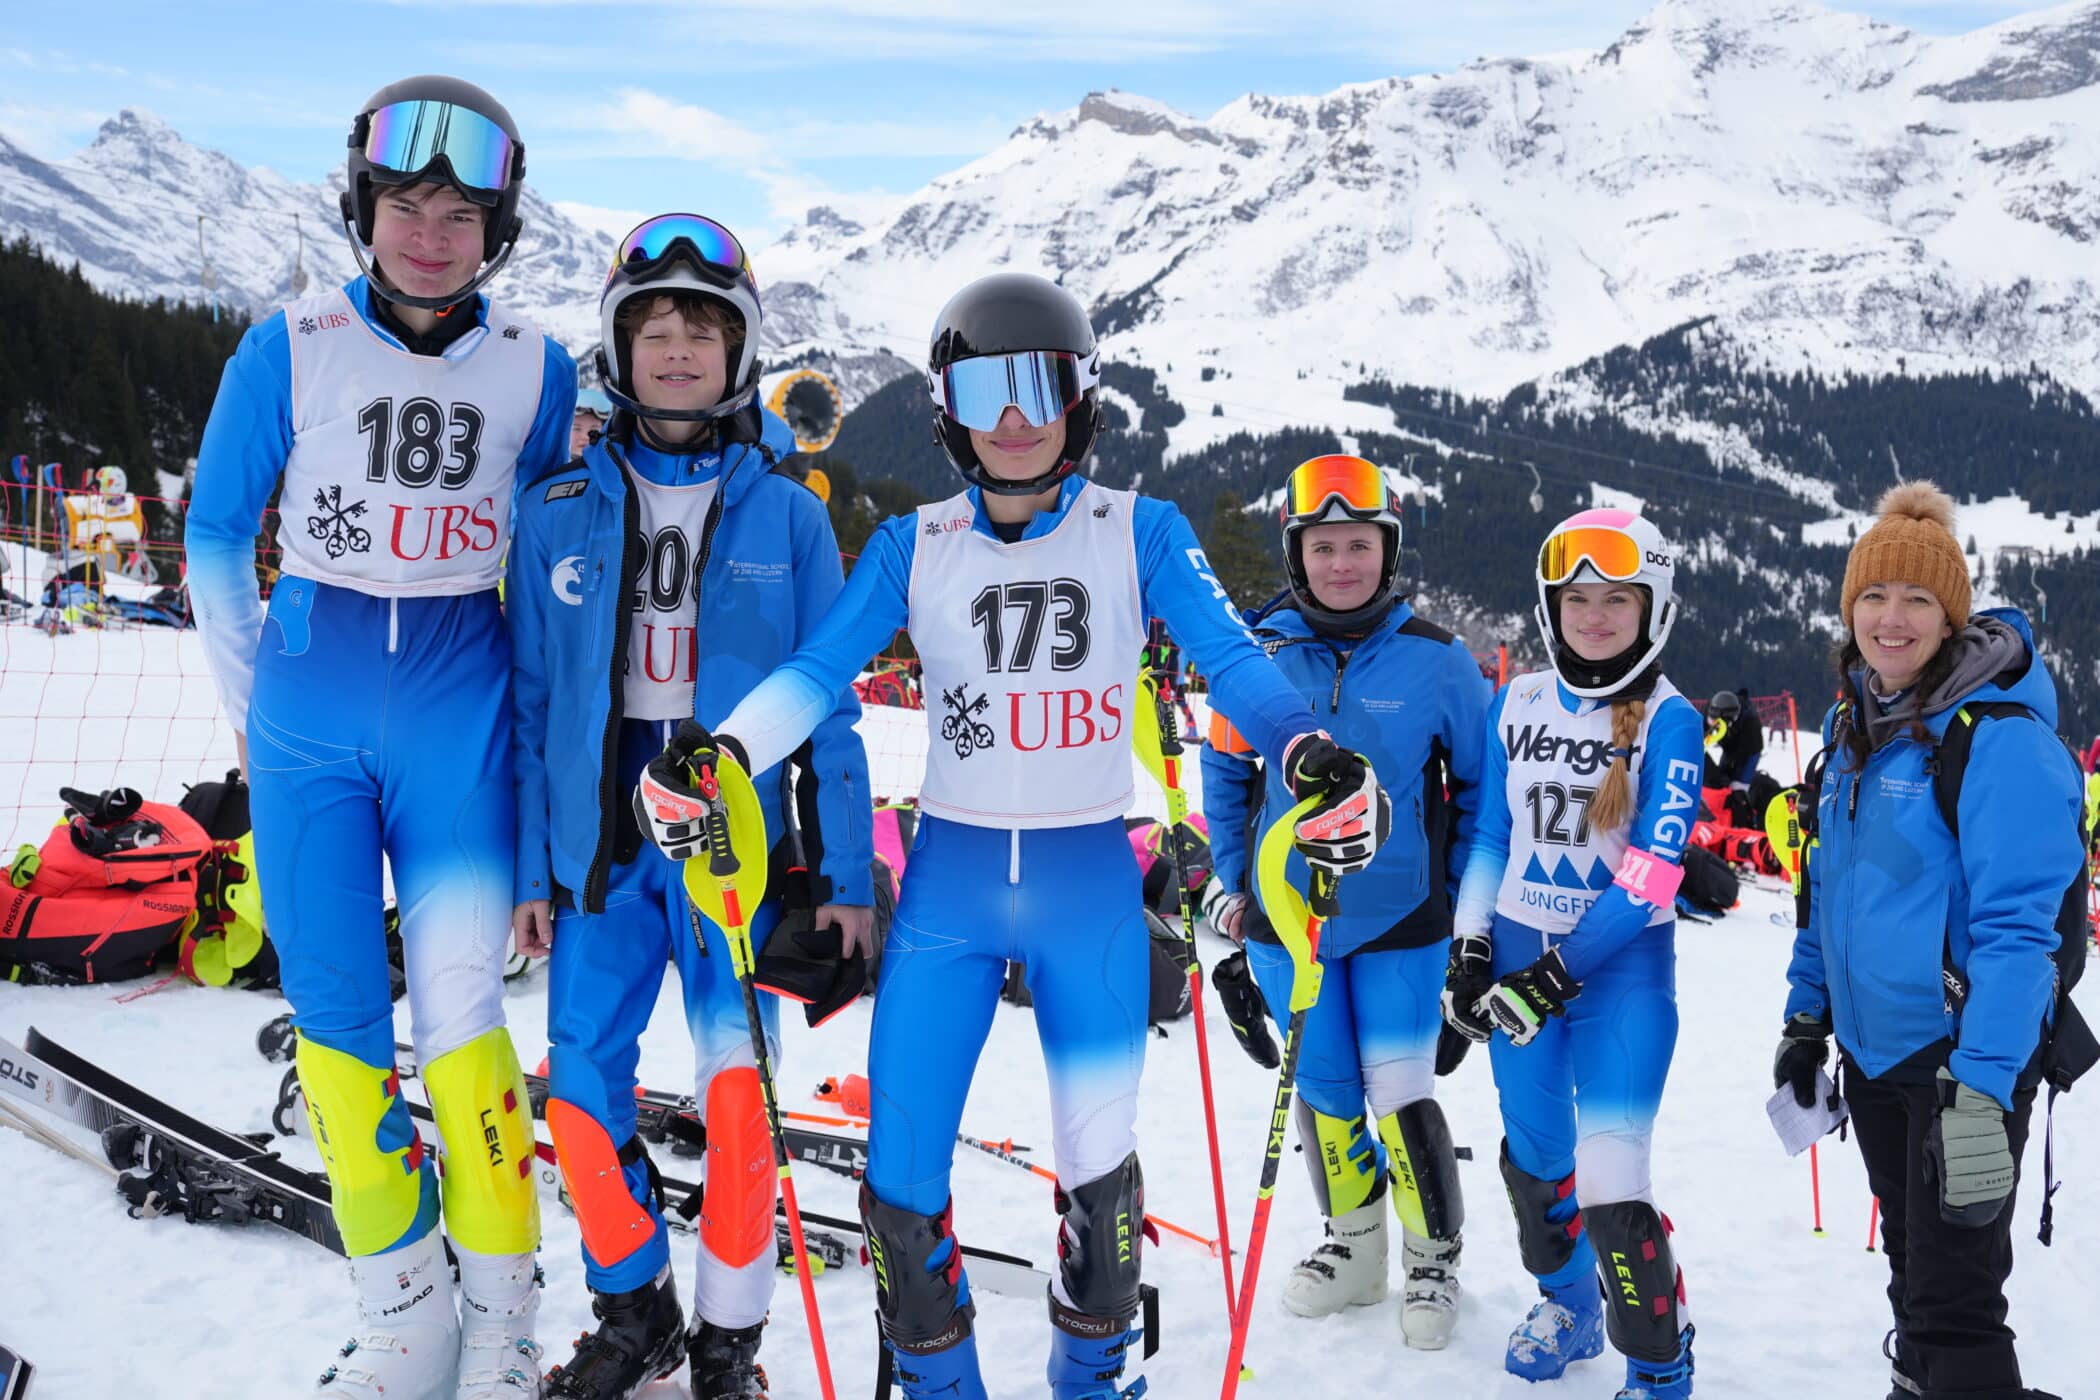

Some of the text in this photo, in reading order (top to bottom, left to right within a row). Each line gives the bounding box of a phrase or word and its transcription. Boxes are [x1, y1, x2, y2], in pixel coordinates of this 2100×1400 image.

[317, 312, 351, 331] UBS
[357, 395, 486, 490] 183
[388, 497, 498, 561] UBS
[942, 516, 972, 534] UBS
[971, 577, 1091, 674] 173
[1006, 684, 1123, 752] UBS
[651, 790, 687, 814] racing
[1316, 807, 1356, 833] racing
[1525, 781, 1599, 847] 127
[479, 1108, 504, 1167] LEKI
[1267, 1086, 1293, 1159] LEKI
[1325, 1141, 1342, 1177] LEKI
[1394, 1147, 1415, 1191] LEKI
[1114, 1212, 1130, 1263] LEKI
[1342, 1223, 1381, 1237] HEAD
[382, 1284, 434, 1316] HEAD
[462, 1288, 488, 1313] AD
[1611, 1251, 1641, 1307] LEKI
